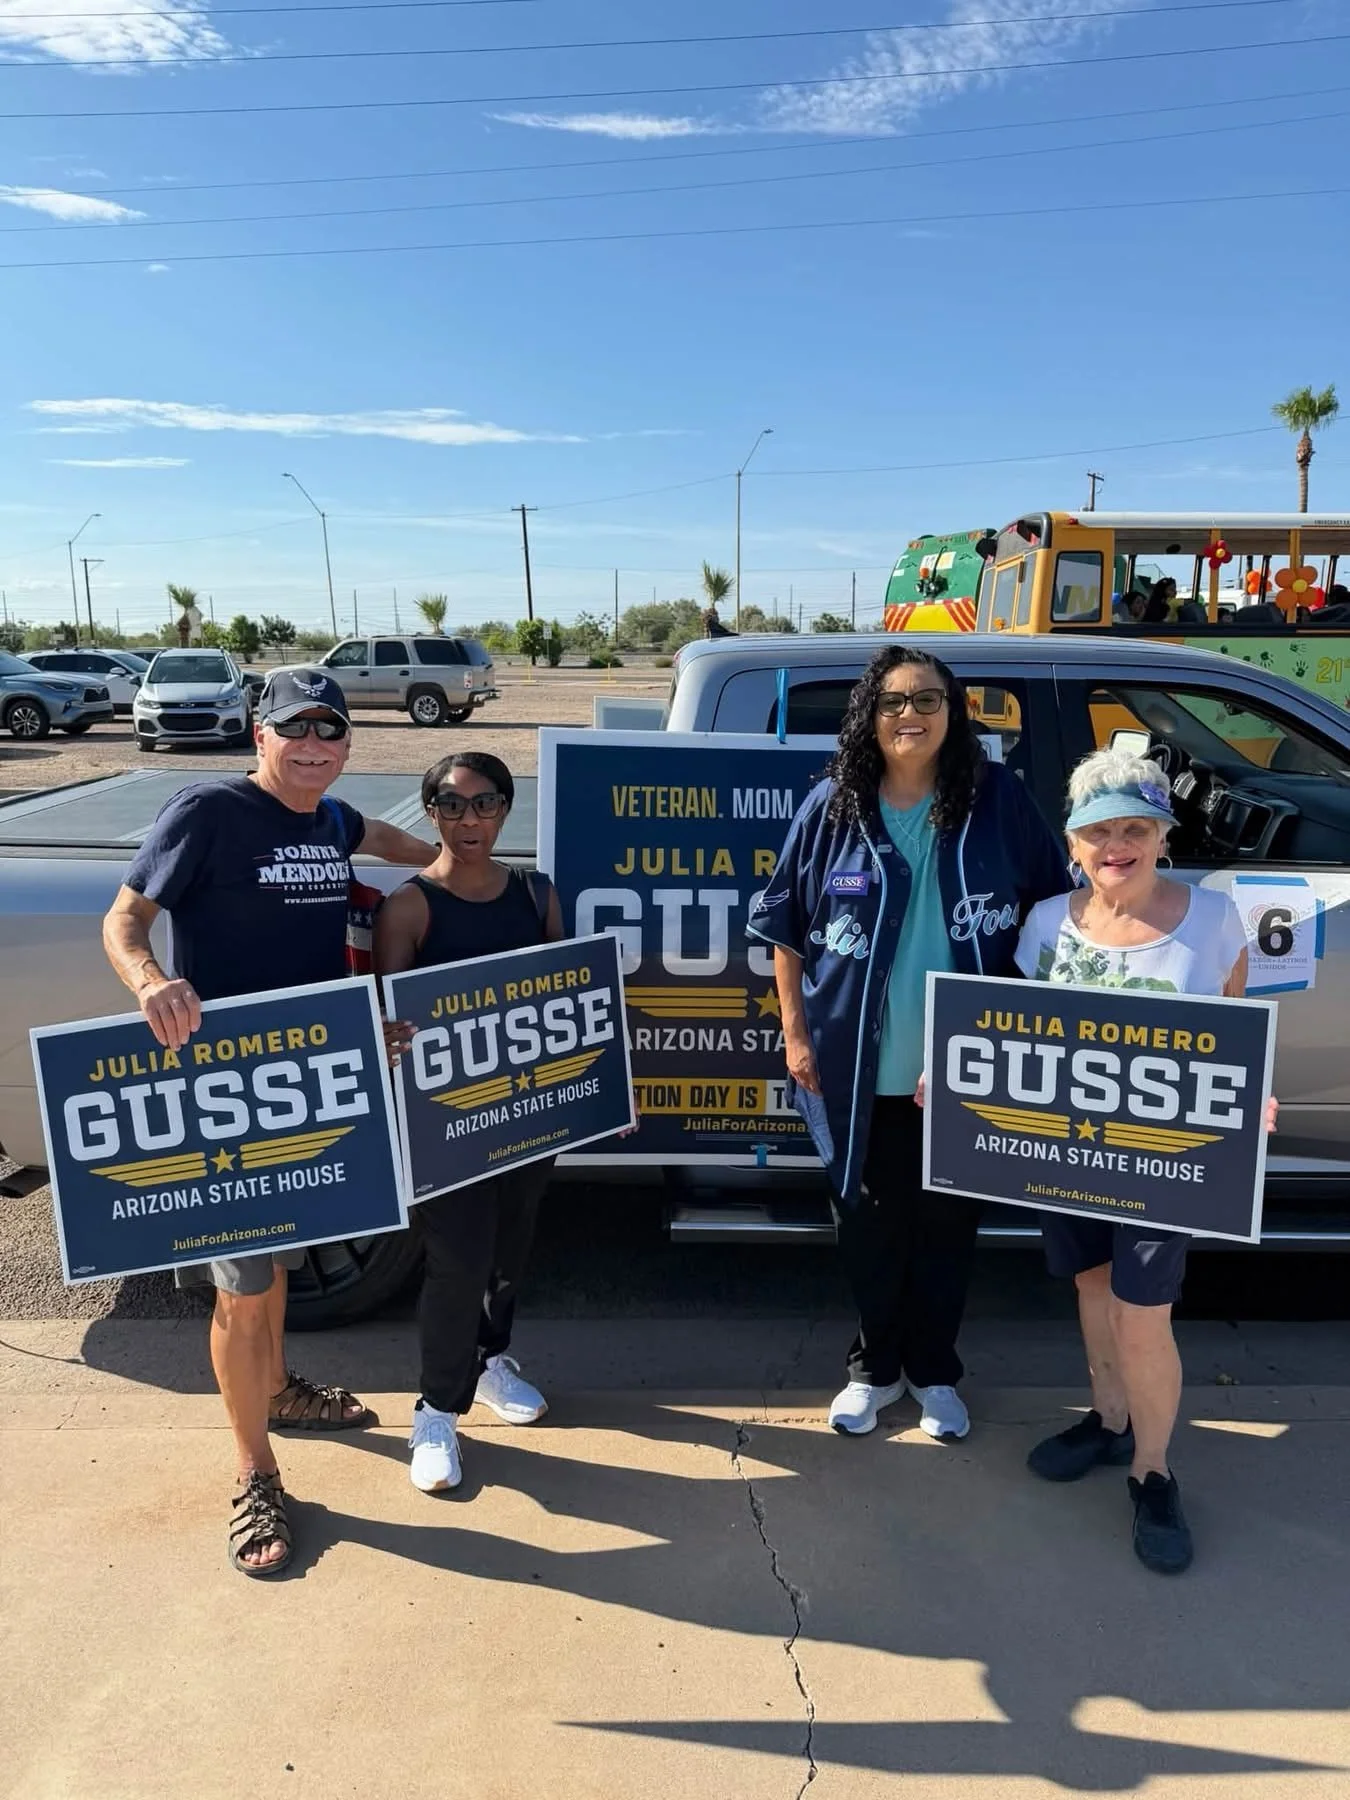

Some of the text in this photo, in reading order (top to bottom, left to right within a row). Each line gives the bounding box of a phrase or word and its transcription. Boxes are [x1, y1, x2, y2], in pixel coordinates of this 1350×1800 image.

[612, 785, 793, 819] VETERAN. MOM
[273, 844, 340, 861] JOANNA
[615, 848, 735, 876] JULIA
[832, 878, 863, 886] GUSSE
[809, 914, 869, 959] Air
[1258, 908, 1293, 956] 6
[431, 967, 591, 1019] JULIA ROMERO
[89, 1023, 328, 1082] JULIA ROMERO
[412, 986, 614, 1091] GUSSE
[976, 1010, 1216, 1054] JULIA ROMERO
[690, 1085, 730, 1108] DAY
[738, 1086, 758, 1108] IS
[946, 1034, 1247, 1130] GUSSE
[63, 1049, 370, 1162] GUSSE
[445, 1078, 600, 1141] ARIZONA STATE HOUSE
[487, 1127, 570, 1162] JuliaForArizona.com
[974, 1133, 1205, 1183] ARIZONA STATE HOUSE
[112, 1162, 347, 1220] ARIZONA STATE HOUSE
[1024, 1183, 1146, 1211] JuliaForArizona.com
[172, 1220, 296, 1251] JuliaForArizona.com
